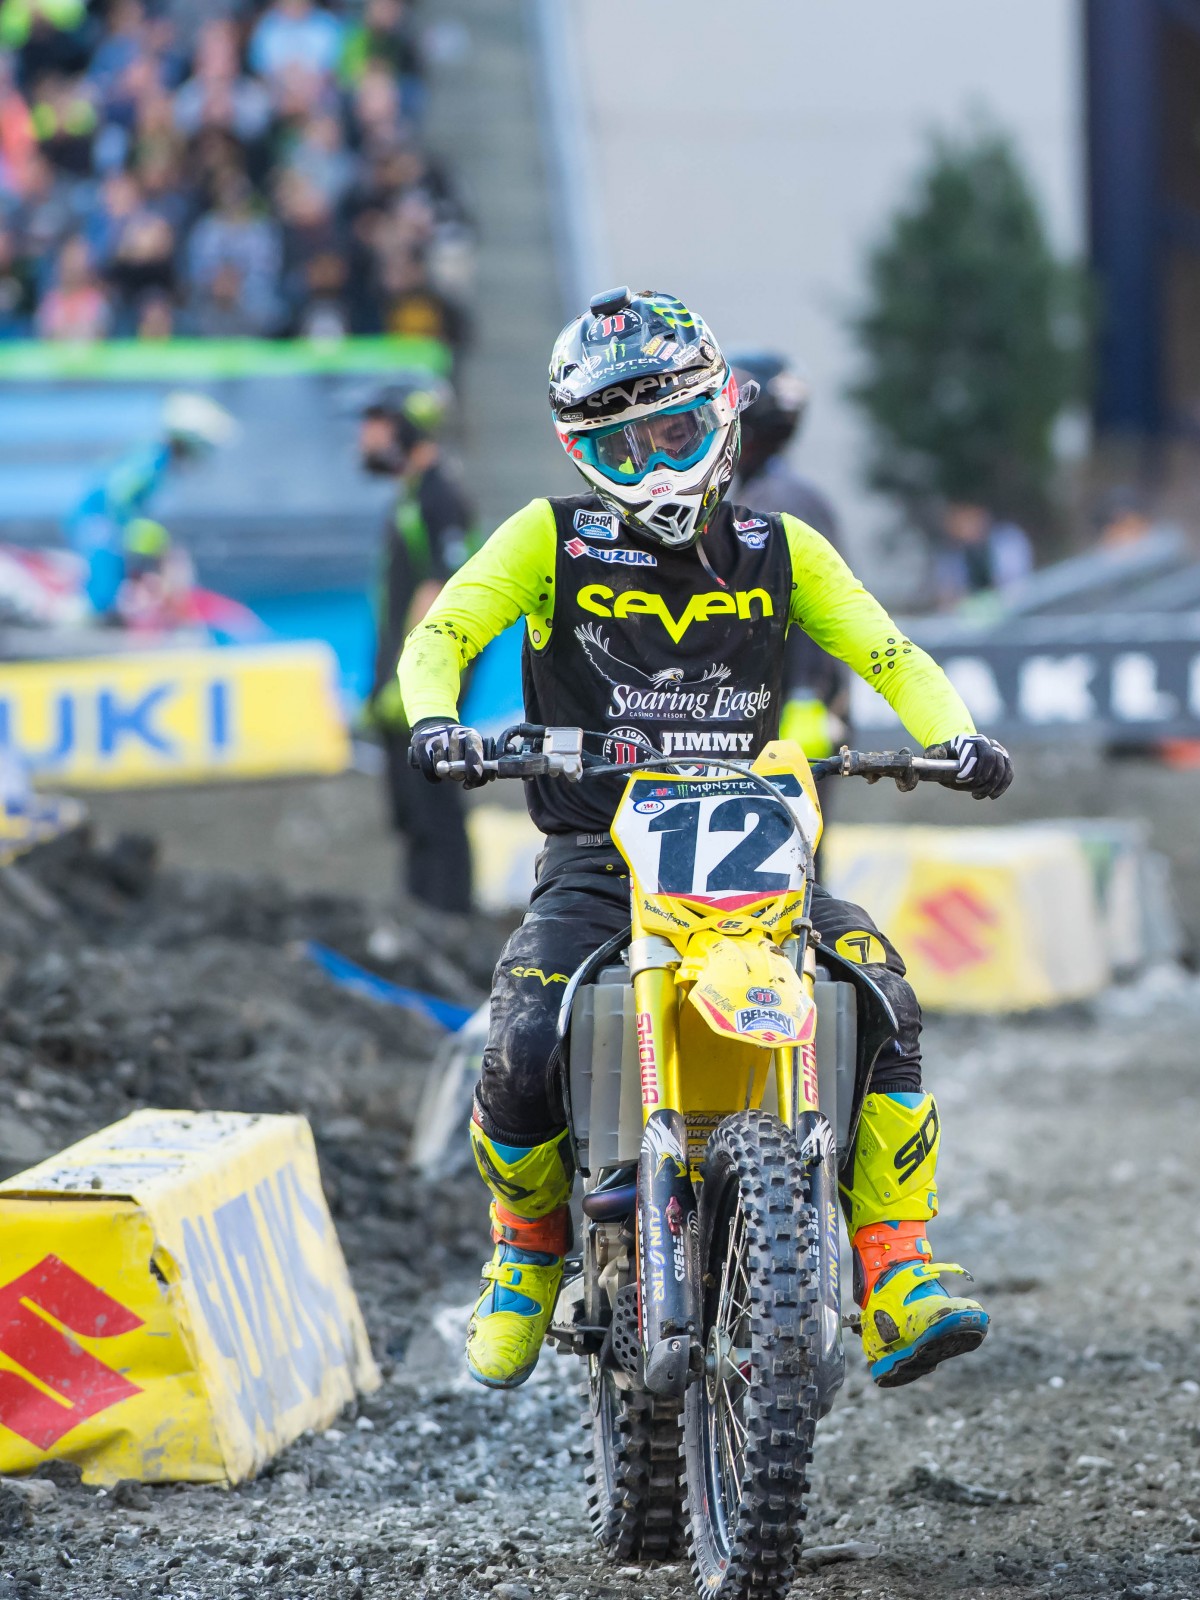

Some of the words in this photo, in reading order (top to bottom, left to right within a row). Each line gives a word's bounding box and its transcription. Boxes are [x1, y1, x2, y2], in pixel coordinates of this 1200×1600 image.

[651, 486, 671, 495] BELL
[587, 546, 657, 566] SUZUKI
[609, 684, 710, 719] Soaring
[710, 683, 771, 719] Eagle
[662, 732, 754, 756] JIMMY
[648, 797, 795, 894] 12
[636, 1012, 659, 1105] SHOWA
